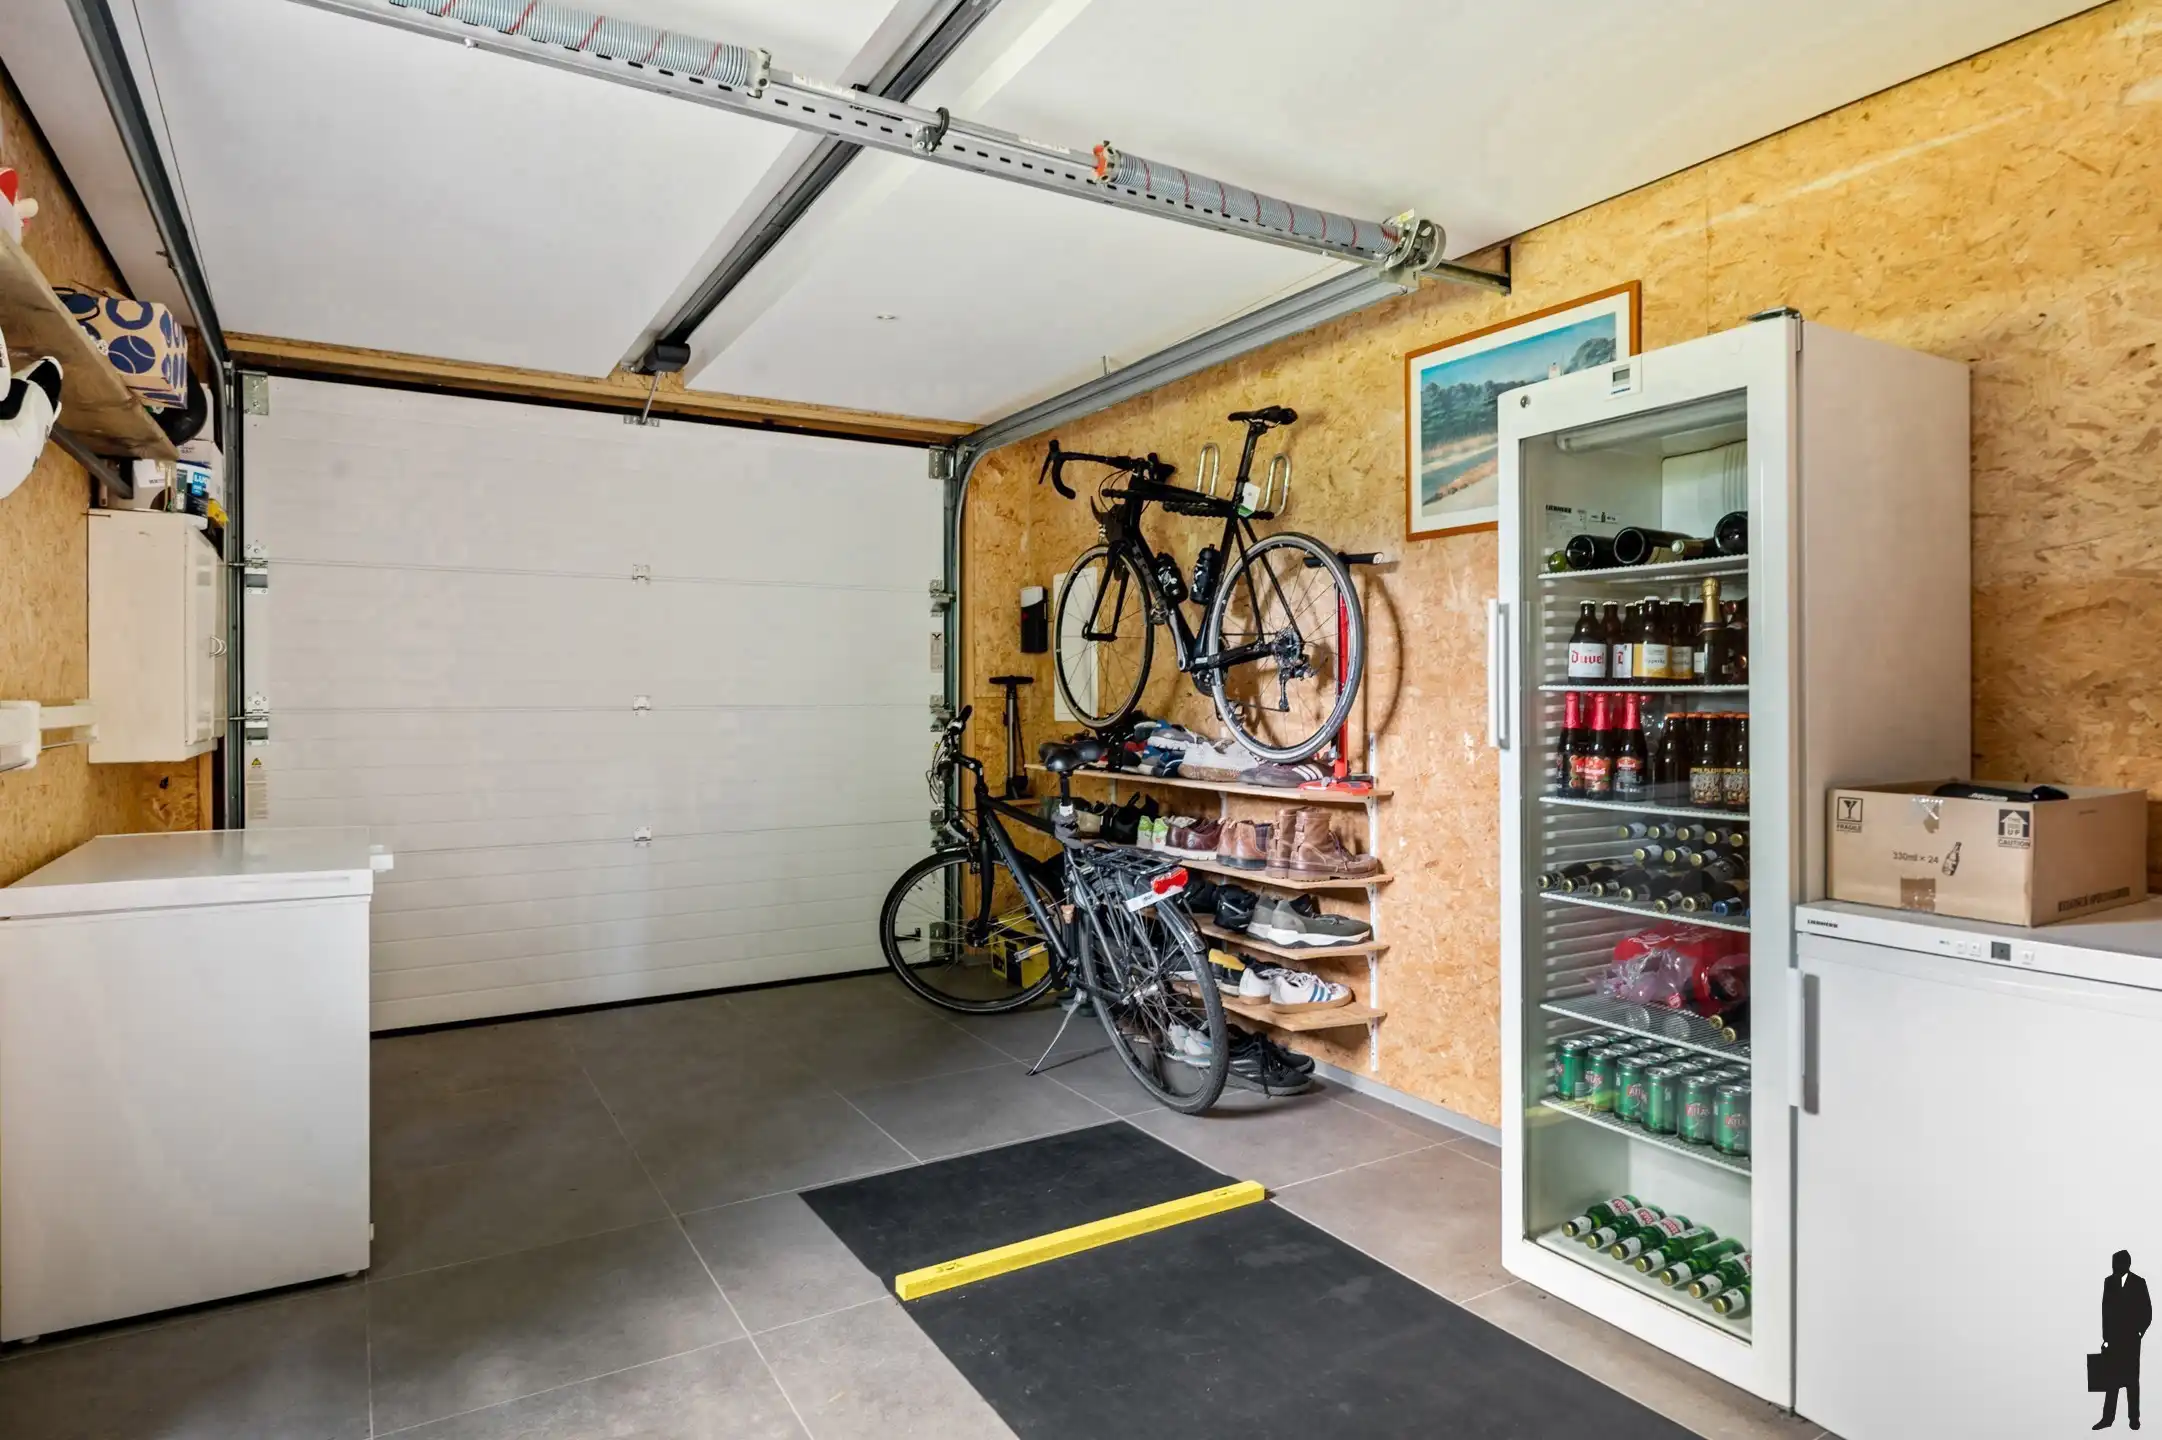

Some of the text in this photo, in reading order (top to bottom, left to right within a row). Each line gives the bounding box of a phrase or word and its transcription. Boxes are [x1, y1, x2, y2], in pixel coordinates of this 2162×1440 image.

[1571, 650, 1605, 664] Duvel
[1836, 823, 1862, 831] FRAGILE
[1998, 838, 2031, 847] CAUTION
[1892, 851, 1918, 862] 330ml
[1928, 855, 1939, 864] 24
